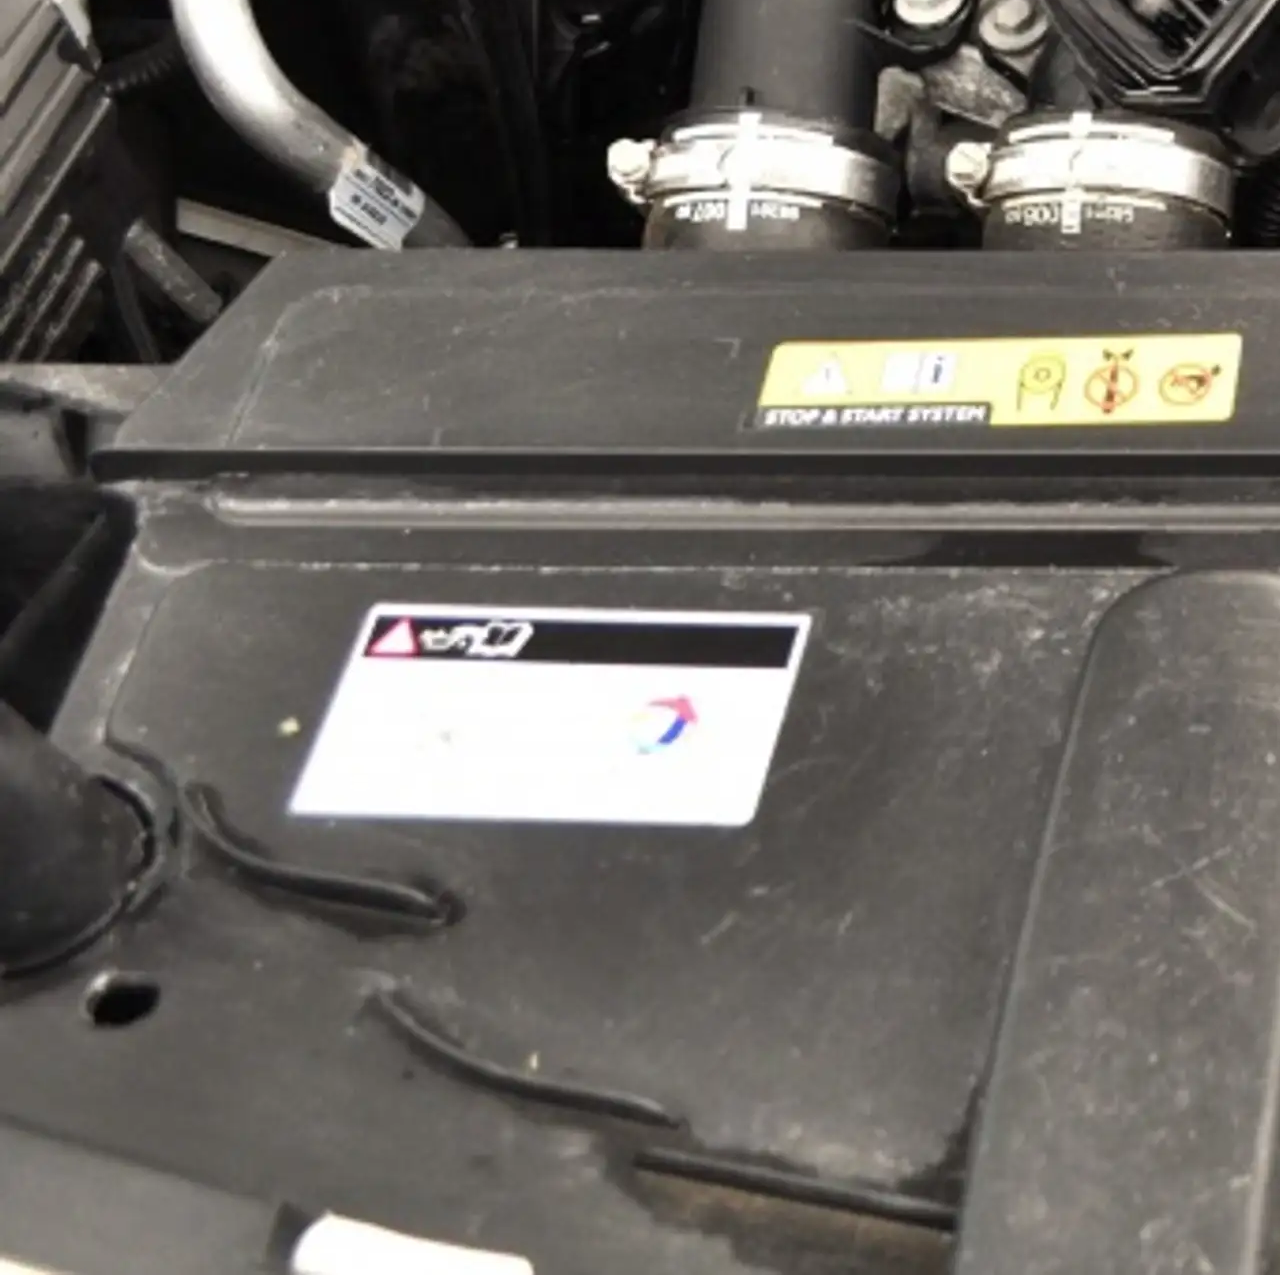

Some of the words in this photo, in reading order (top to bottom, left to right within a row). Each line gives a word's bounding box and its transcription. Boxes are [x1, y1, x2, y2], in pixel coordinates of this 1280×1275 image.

[764, 408, 821, 426] STOP
[841, 408, 904, 424] START
[907, 406, 986, 423] SYSTEM
